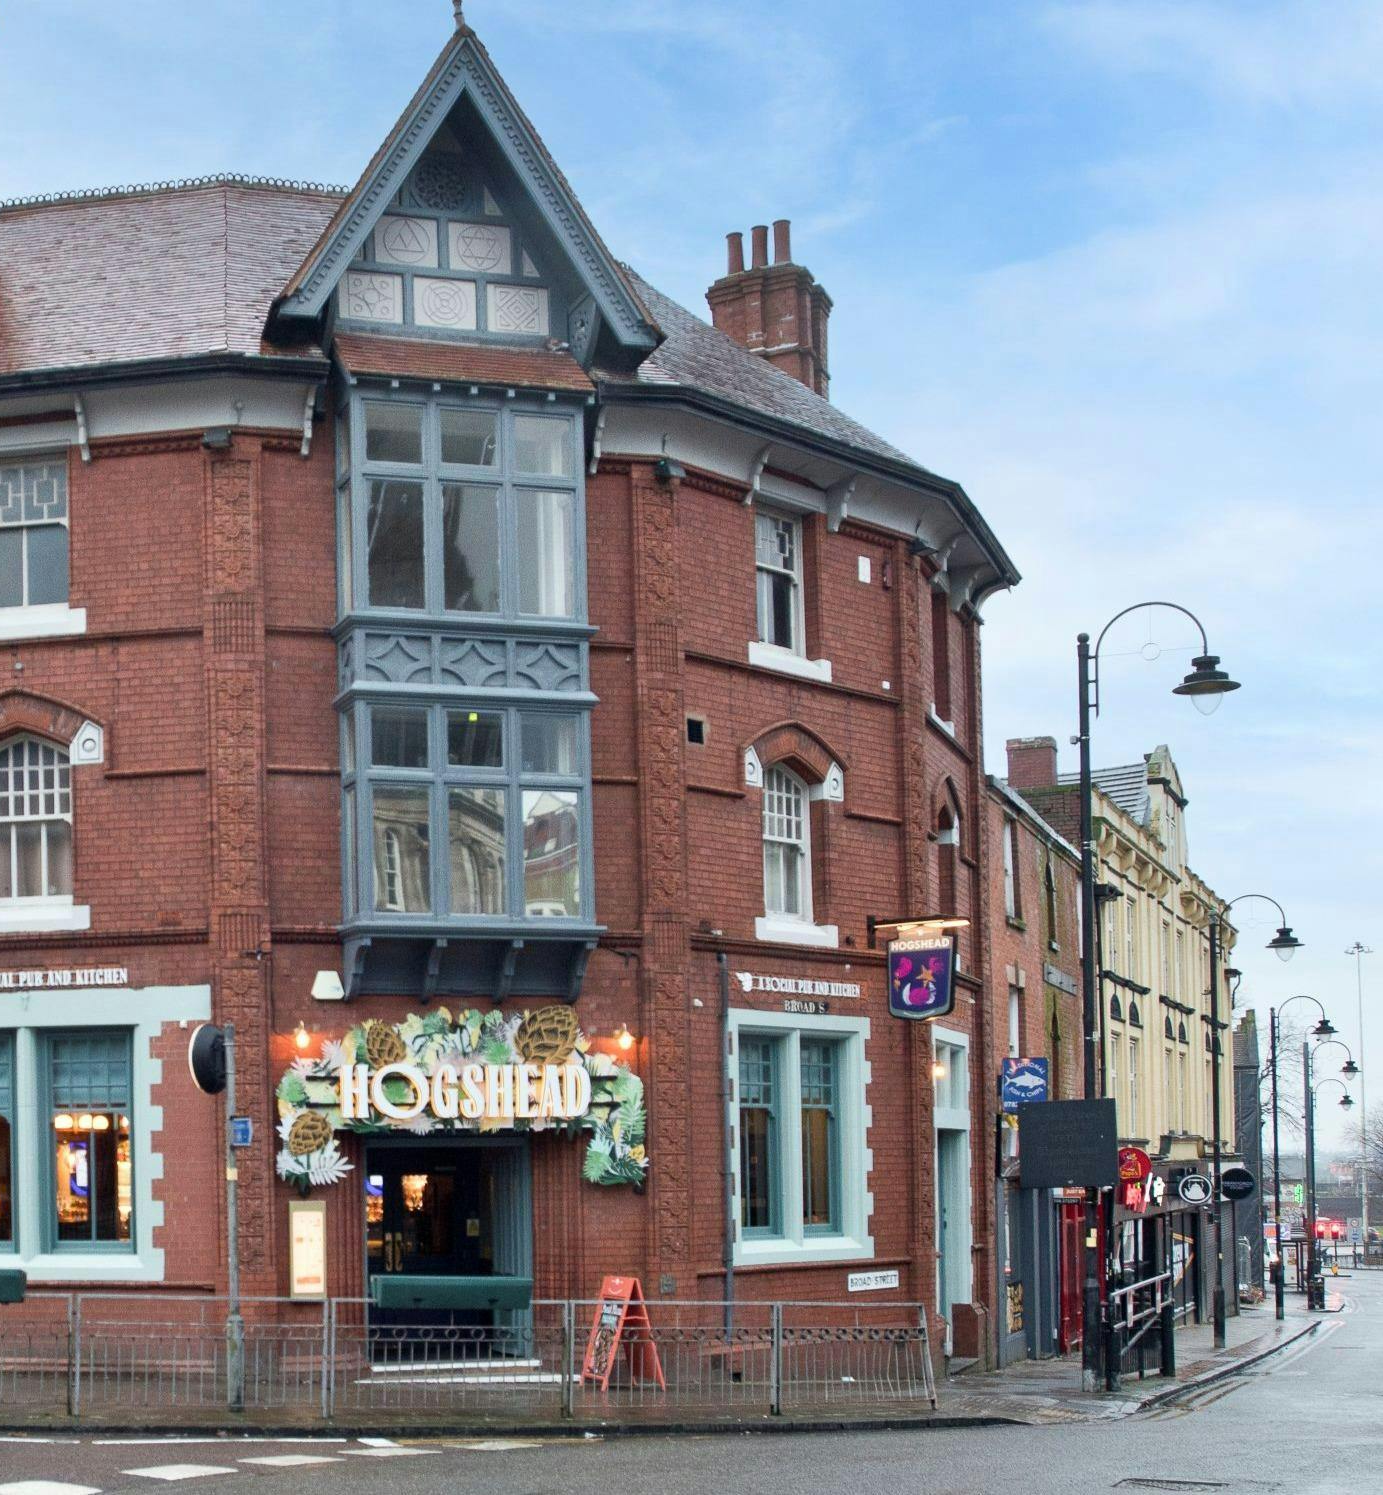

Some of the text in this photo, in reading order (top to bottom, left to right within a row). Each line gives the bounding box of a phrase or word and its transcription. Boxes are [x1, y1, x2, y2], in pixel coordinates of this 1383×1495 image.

[891, 938, 950, 951] HOGSHEAD
[19, 970, 43, 987] PUB
[46, 969, 71, 986] AND
[75, 967, 128, 985] KITCHEN
[784, 1000, 816, 1013] BROAD
[340, 1063, 592, 1119] HOGSHEAD
[850, 1274, 898, 1288] BROAD STREET
